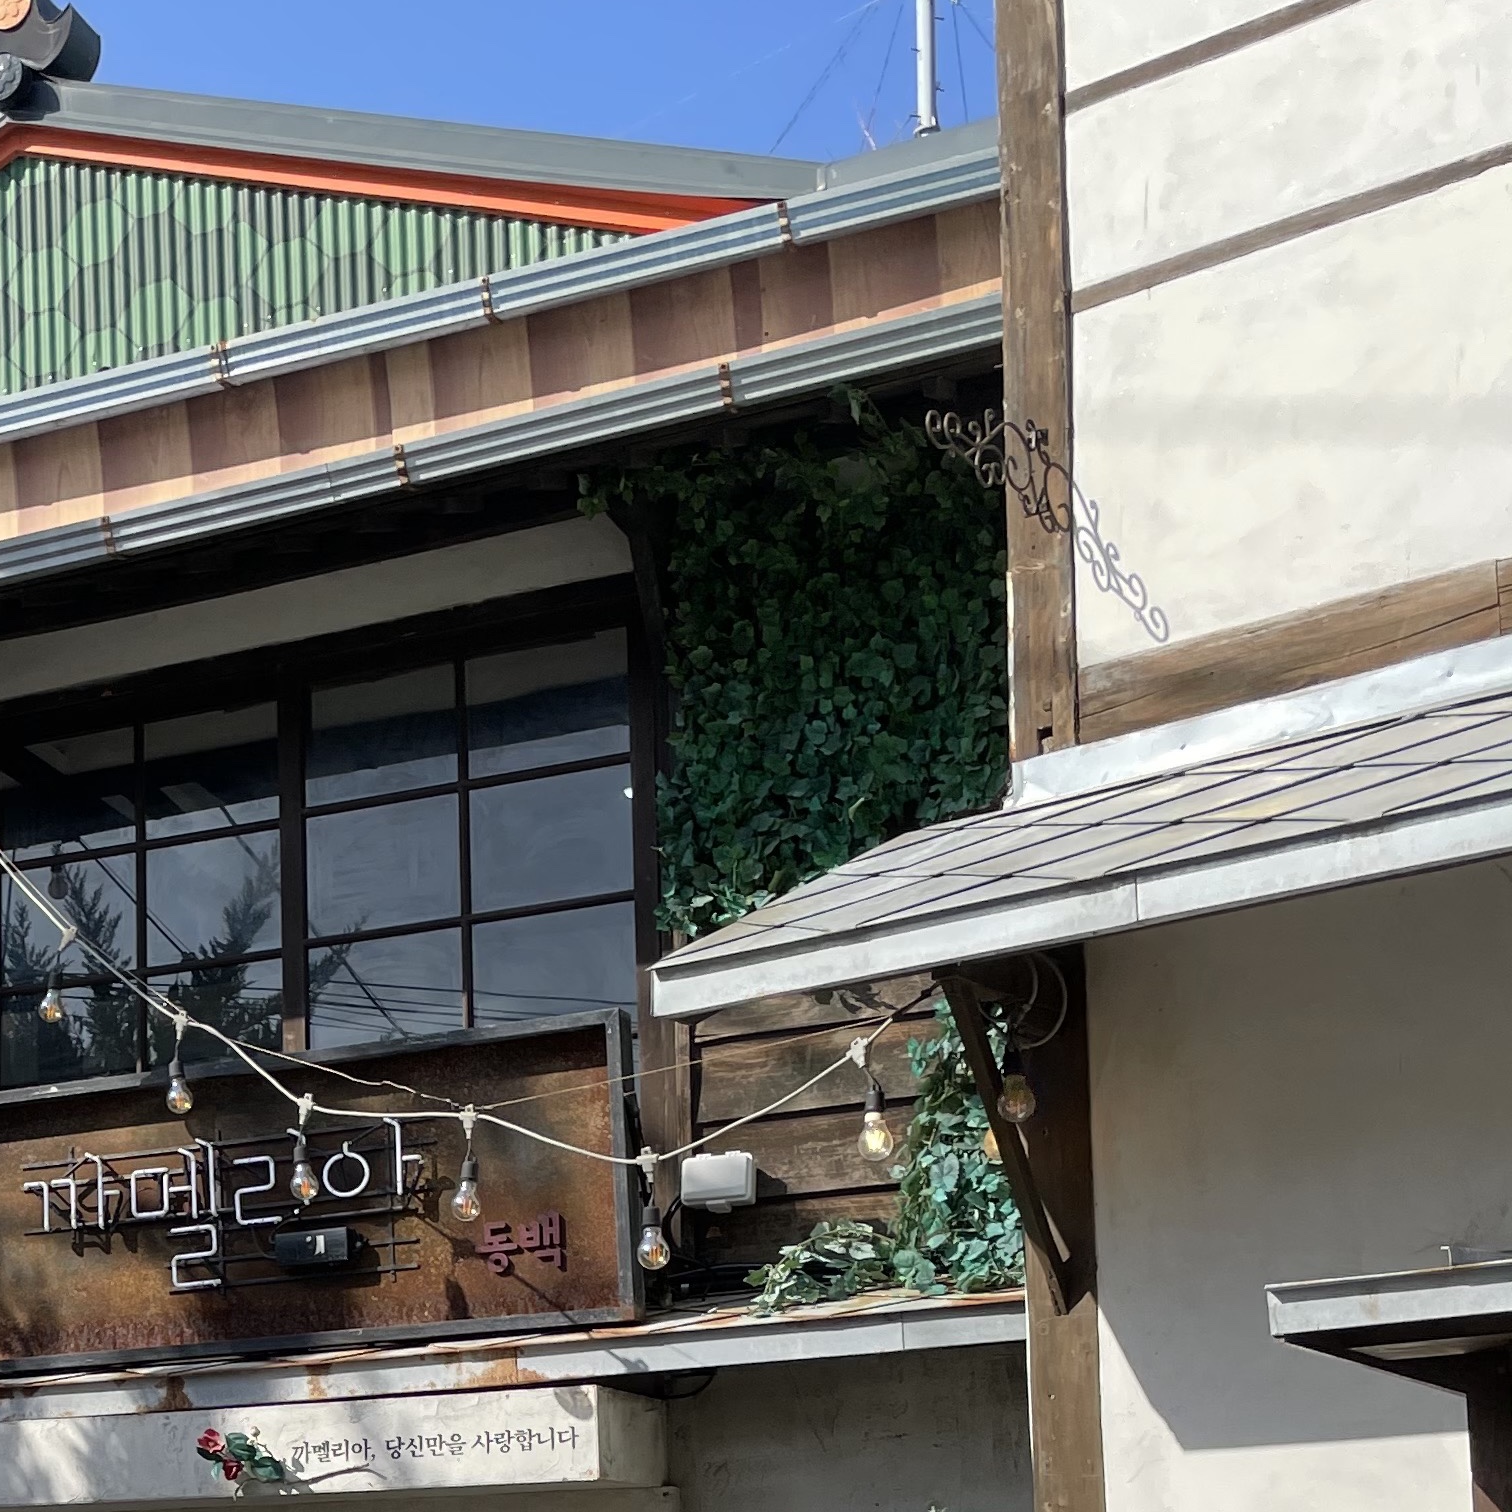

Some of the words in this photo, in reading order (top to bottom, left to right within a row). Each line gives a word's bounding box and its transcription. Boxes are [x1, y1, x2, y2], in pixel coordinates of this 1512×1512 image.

[23, 1117, 424, 1289] 까멜리아
[475, 1209, 565, 1274] 동백
[292, 1438, 376, 1465] 까멜리아,
[385, 1432, 467, 1460] 당신만을
[471, 1425, 580, 1456] 사랑합니다
